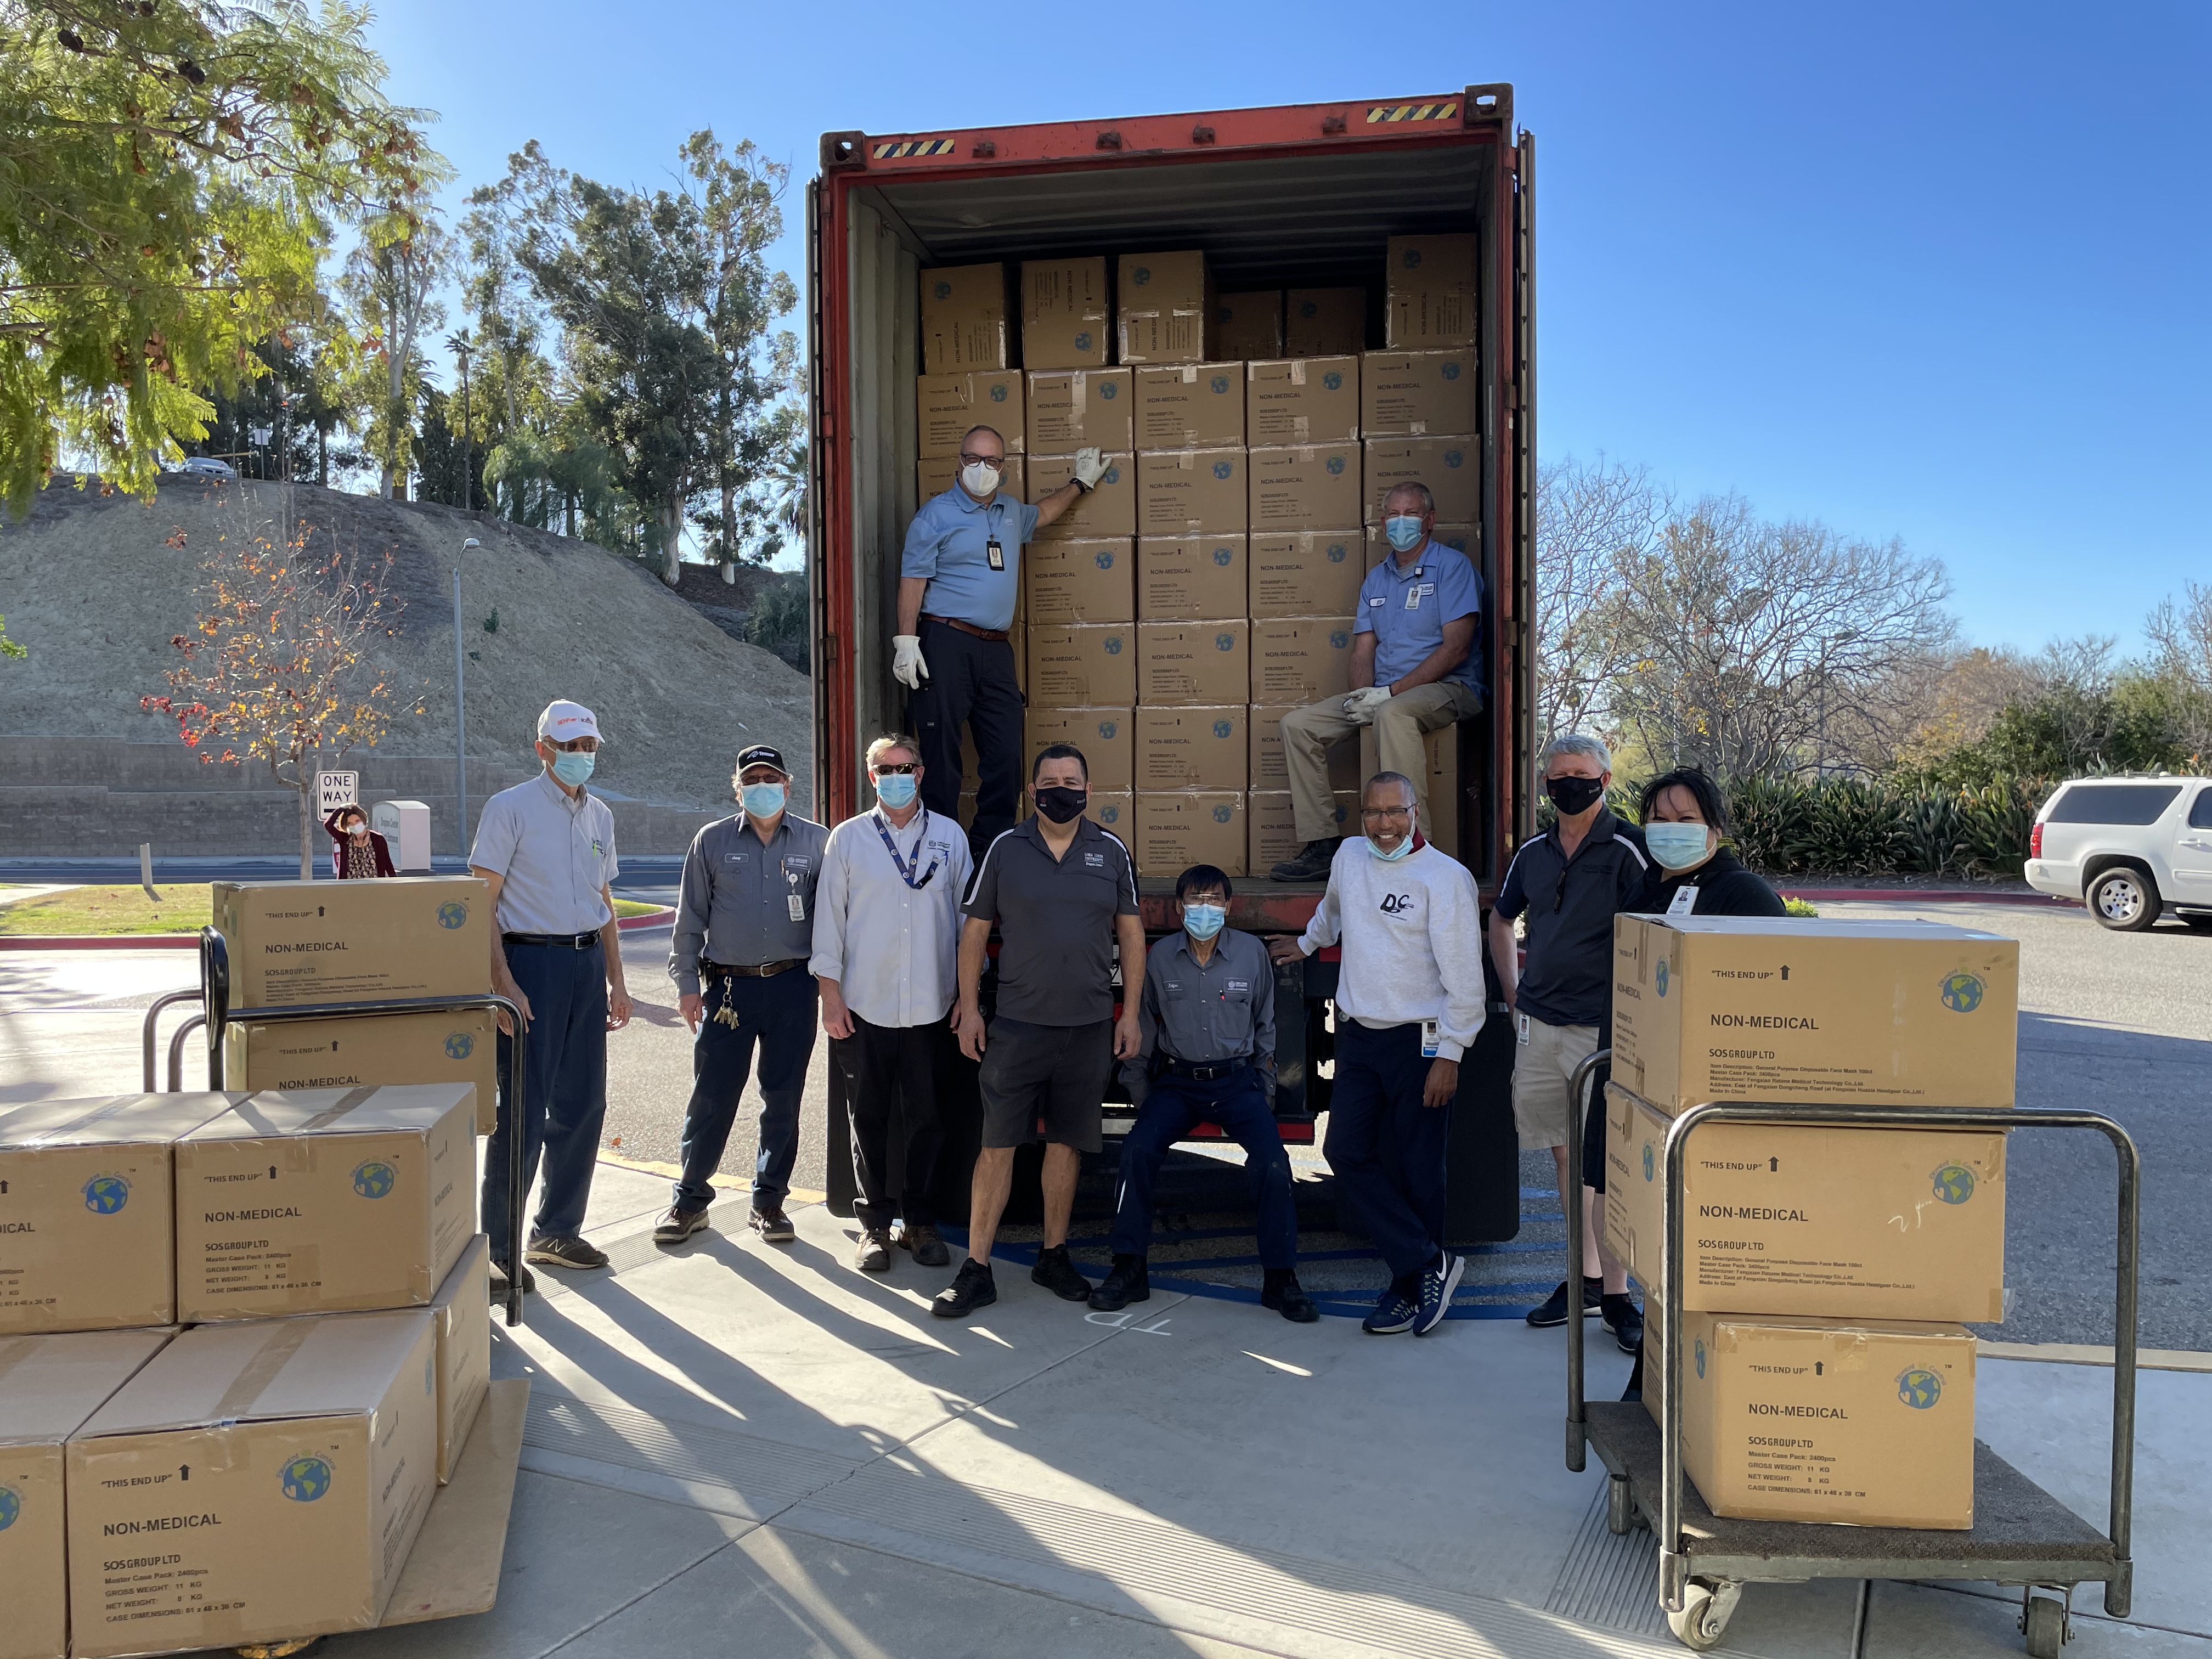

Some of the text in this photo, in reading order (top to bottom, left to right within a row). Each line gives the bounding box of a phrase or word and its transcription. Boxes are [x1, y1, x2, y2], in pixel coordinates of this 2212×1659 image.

[324, 776, 351, 786] ONE
[323, 791, 352, 802] WAY
[266, 941, 348, 953] NON-MEDICAL
[1711, 1014, 1819, 1029] NON-MEDICAL
[279, 1075, 360, 1090] NON-MEDICAL
[205, 1206, 301, 1222] NON-MEDICAL
[1700, 1205, 1808, 1221] NON-MEDICAL
[1749, 1403, 1847, 1419] NON-MEDICAL
[131, 1476, 151, 1485] END
[1768, 1486, 1812, 1494] DIMENSIONS:
[104, 1513, 221, 1536] NON-MEDICAL
[177, 1568, 208, 1577] 2400pcs
[105, 1588, 134, 1596] GROSS
[136, 1584, 171, 1593] WEIGHT:
[124, 1598, 159, 1607] WEIGHT:
[106, 1614, 128, 1622] CASE
[131, 1608, 183, 1620] DIMENSIONS:
